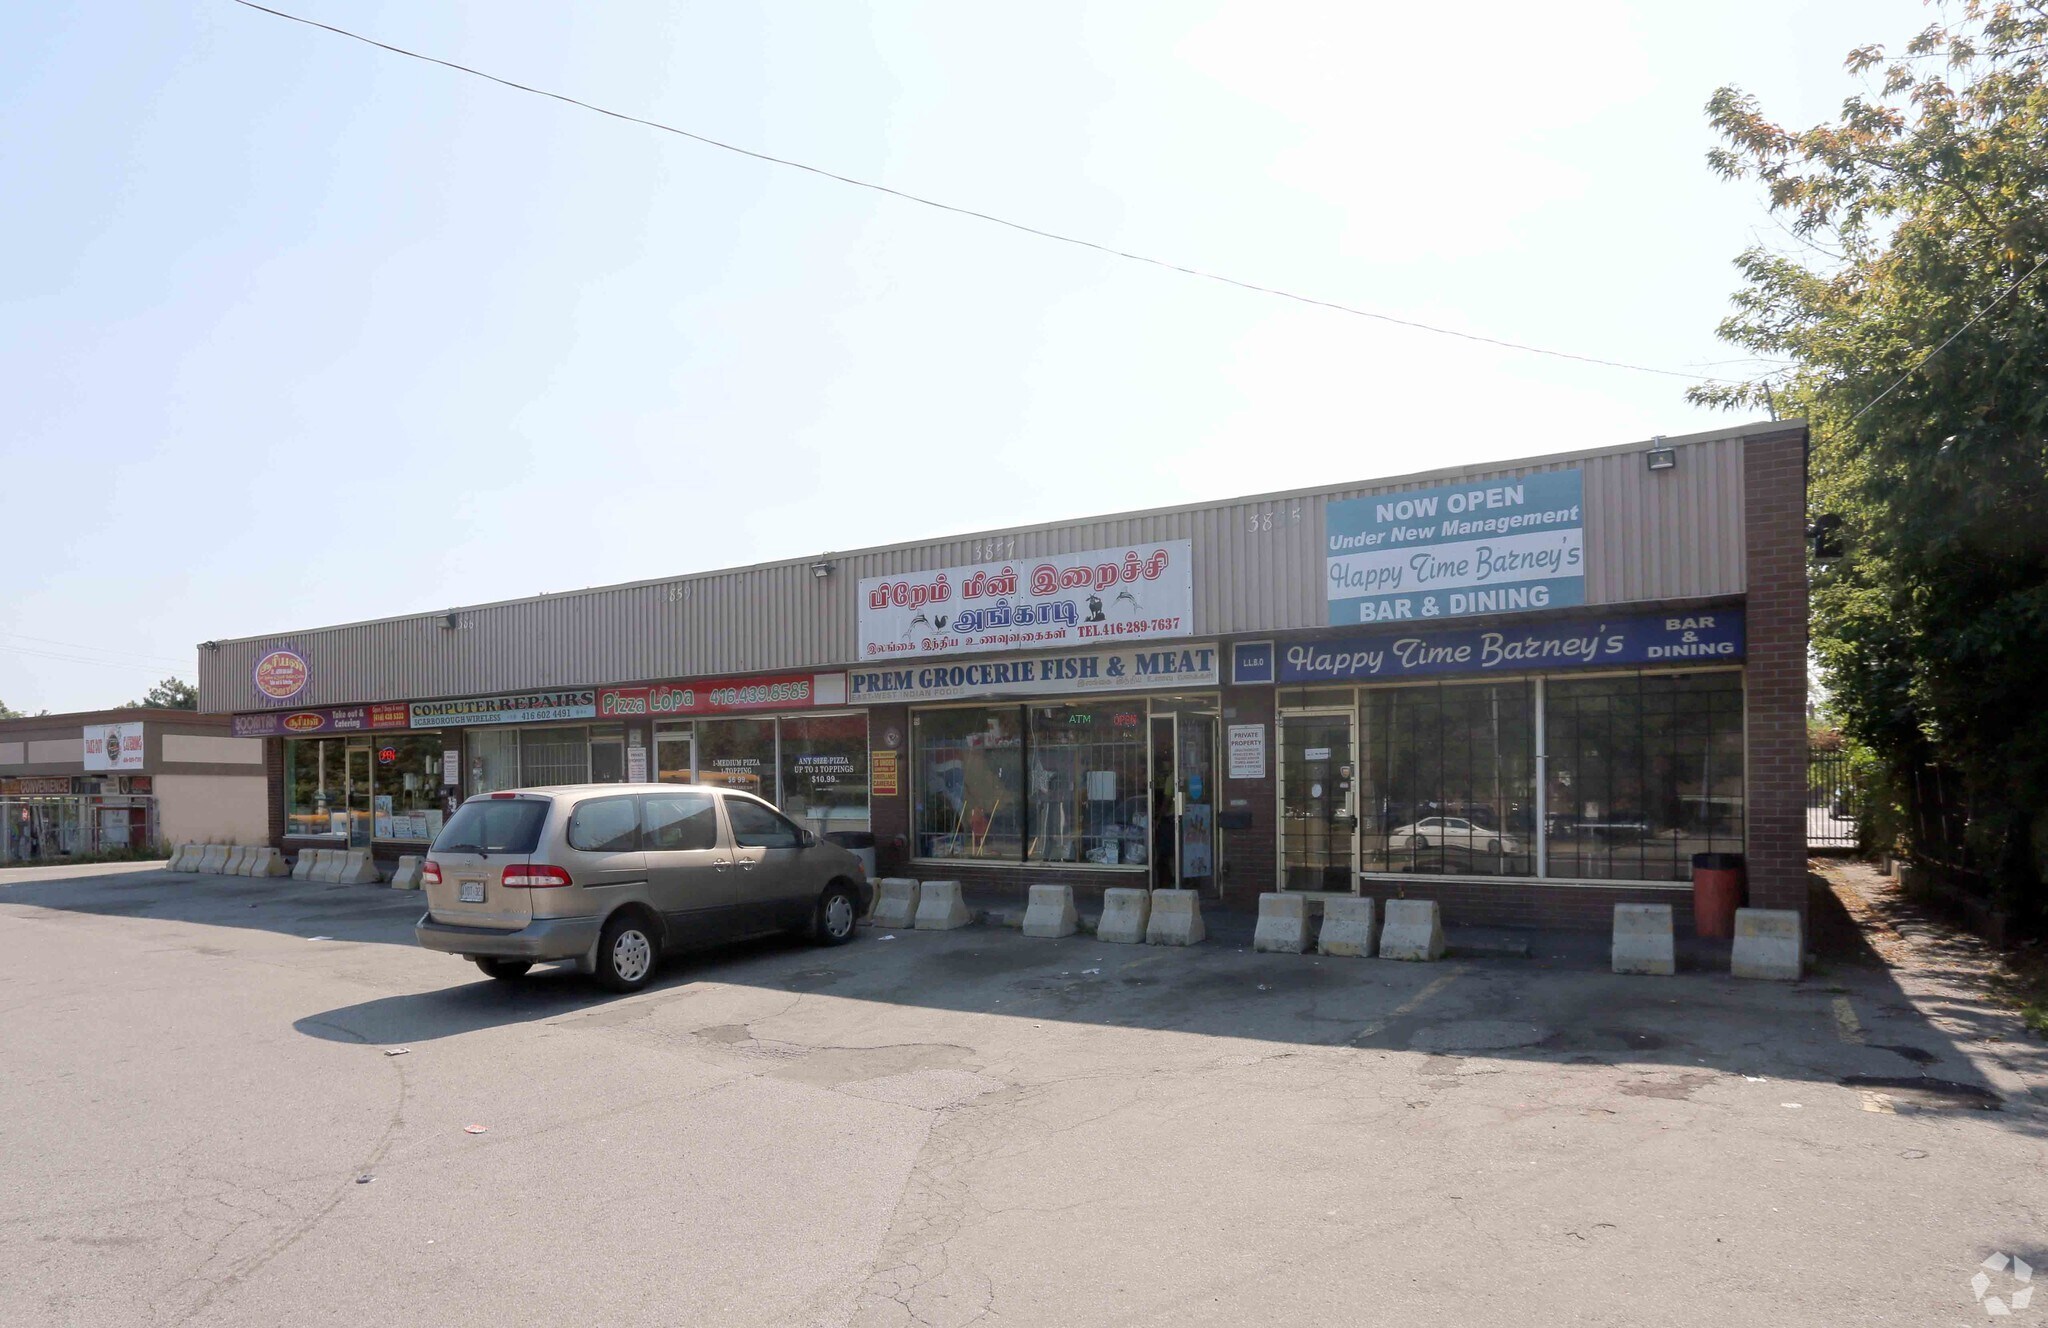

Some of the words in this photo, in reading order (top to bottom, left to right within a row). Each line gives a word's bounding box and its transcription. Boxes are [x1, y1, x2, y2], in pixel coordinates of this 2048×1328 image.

[1376, 496, 1439, 523] NOW
[1447, 485, 1524, 514] OPEN
[1329, 532, 1386, 550] Under
[1391, 526, 1436, 542] New
[1441, 505, 1580, 537] Management
[1330, 563, 1403, 591] Happy
[1410, 553, 1469, 583] Time
[1476, 536, 1580, 581] Barney's
[962, 566, 1019, 599] மீன்
[1030, 549, 1169, 596] இறைச்சி
[1360, 599, 1413, 622] BAR
[1421, 596, 1440, 617] &
[1450, 586, 1549, 615] DINING
[1077, 617, 1181, 638] TEL.416-289-7637
[1665, 616, 1715, 631] BAR
[1682, 631, 1699, 643] &
[1287, 645, 1384, 675] Happy
[1392, 638, 1471, 668] Time
[1480, 624, 1624, 668] Barney's
[1648, 642, 1735, 658] DINING
[852, 670, 914, 693] PREM
[918, 661, 1035, 690] GROCERIE
[1040, 656, 1099, 681] FISH
[1106, 656, 1126, 677] &
[1135, 649, 1214, 675] MEAT
[412, 700, 497, 717] COMPUTER
[499, 692, 594, 711] REPAIRS
[602, 692, 646, 715] Pizza
[709, 681, 810, 705] 416.439.8585
[332, 711, 346, 719] Take
[414, 714, 466, 726] SCARBOROUGH
[467, 713, 501, 722] WIRELESS
[521, 711, 535, 721] 416
[536, 710, 551, 719] 602
[552, 708, 571, 718] 4491
[1068, 714, 1091, 724] ATM
[335, 719, 361, 729] Catering
[379, 749, 397, 761] OPEN
[743, 758, 760, 766] PIZZA
[799, 757, 812, 765] ANY
[830, 756, 849, 764] PIZZA
[820, 765, 854, 773] TOPPINGS
[20, 779, 69, 794] CONVENIENCE
[811, 775, 836, 783] $10.99
